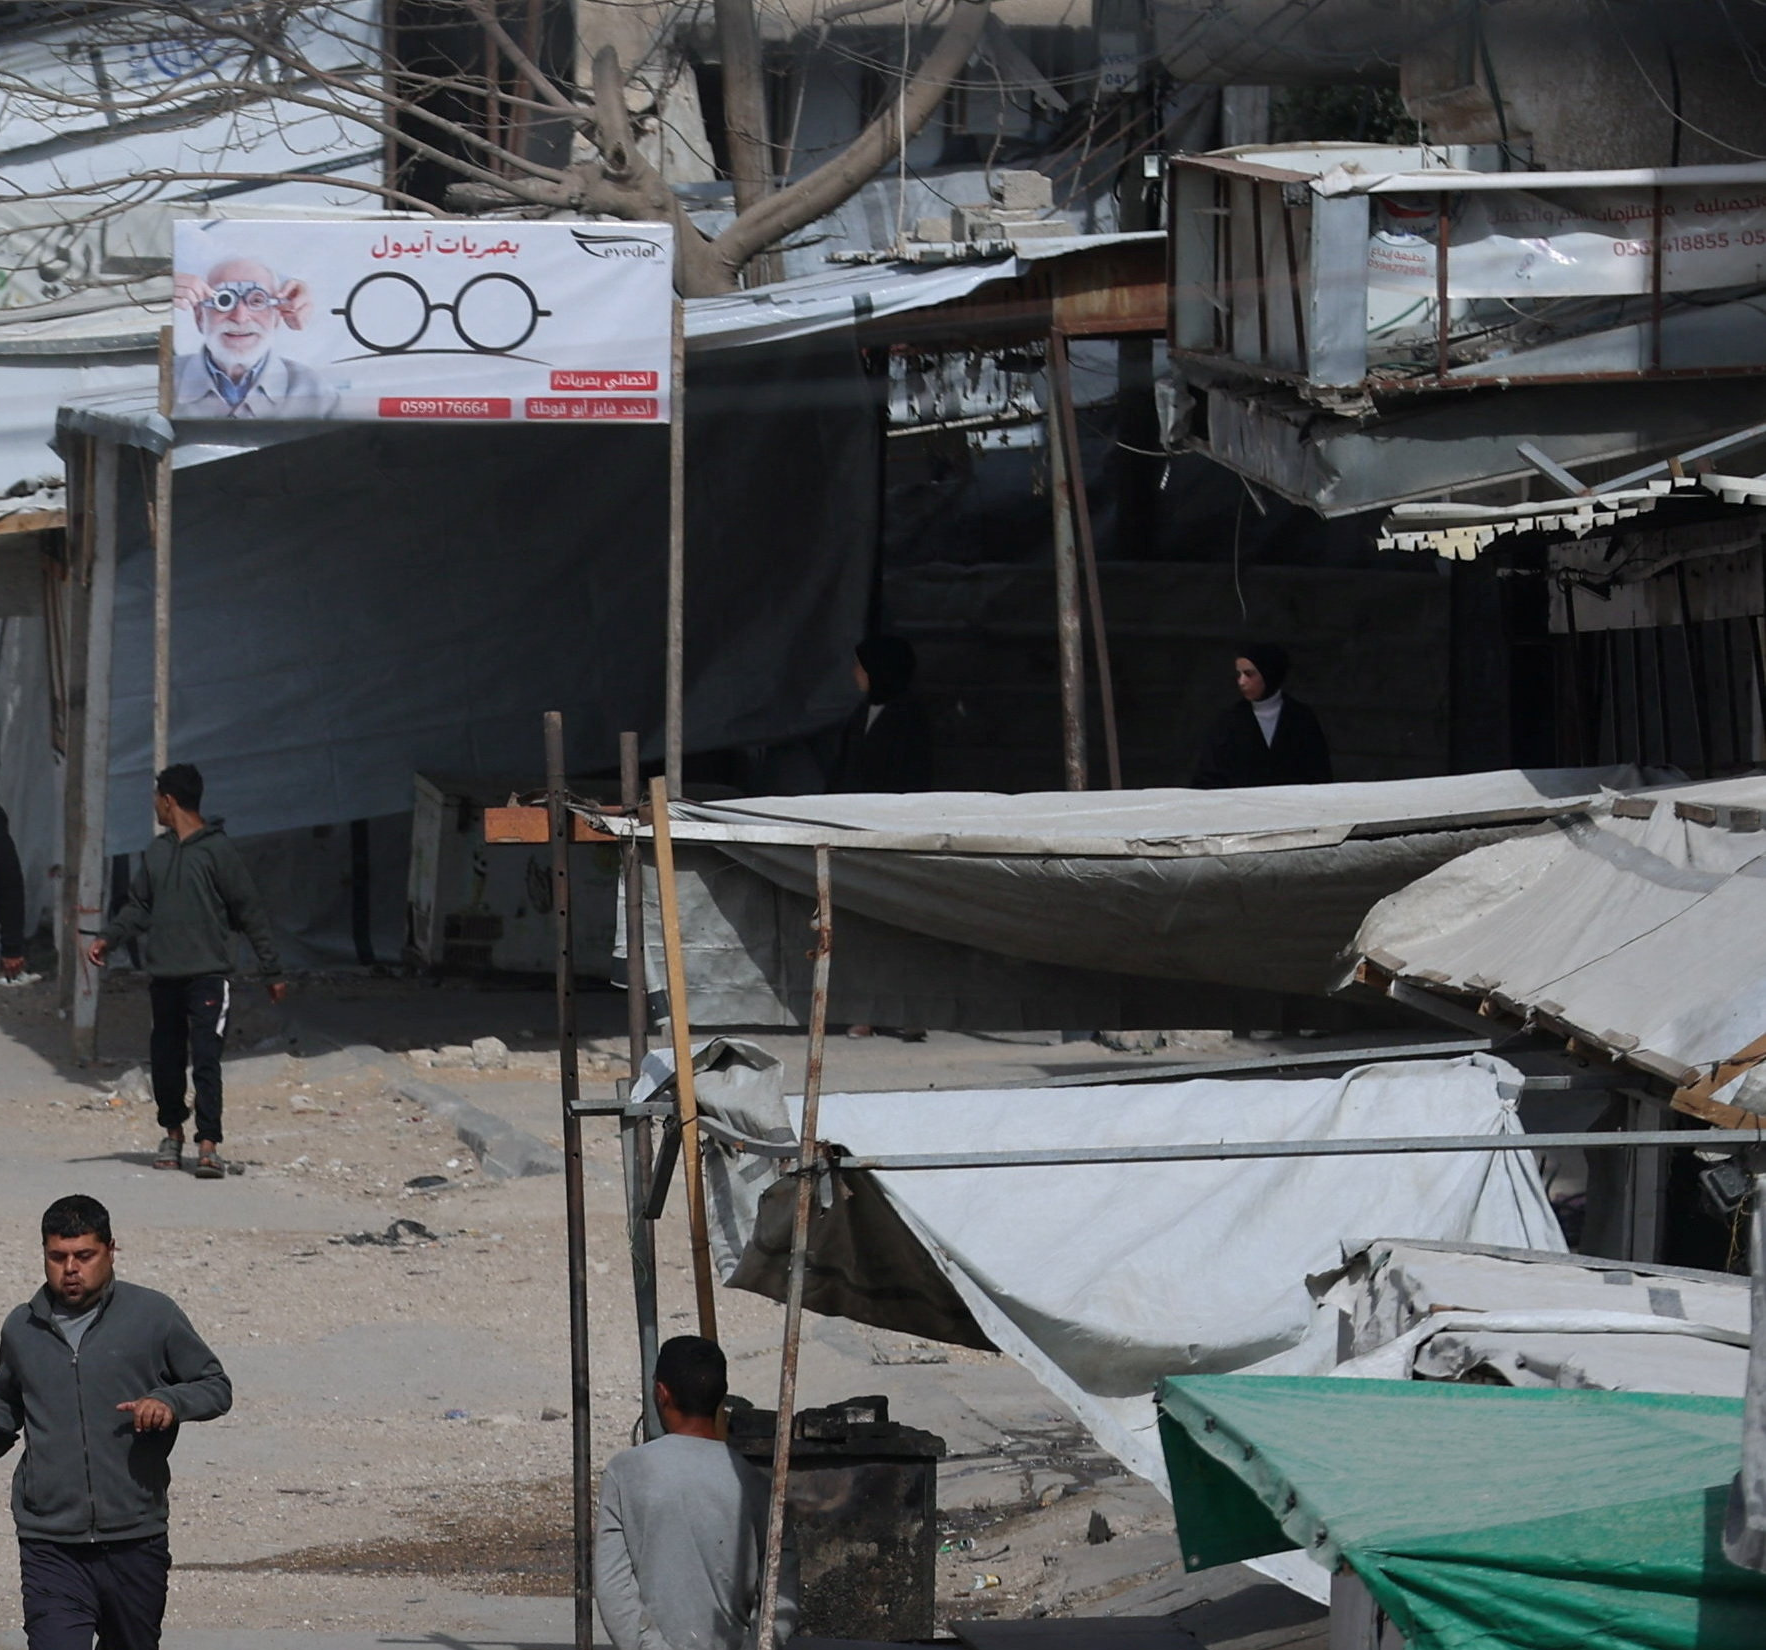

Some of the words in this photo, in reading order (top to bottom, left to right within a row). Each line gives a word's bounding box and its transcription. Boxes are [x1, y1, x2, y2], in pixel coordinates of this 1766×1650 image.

[371, 229, 433, 260] آيدول
[437, 233, 521, 261] بصريات
[1613, 232, 1730, 258] 056418855
[605, 371, 652, 391] أخصائي
[399, 401, 489, 416] 0599176664
[570, 399, 590, 418] أبو
[591, 401, 617, 418] فايز
[623, 399, 652, 416] أحمد
